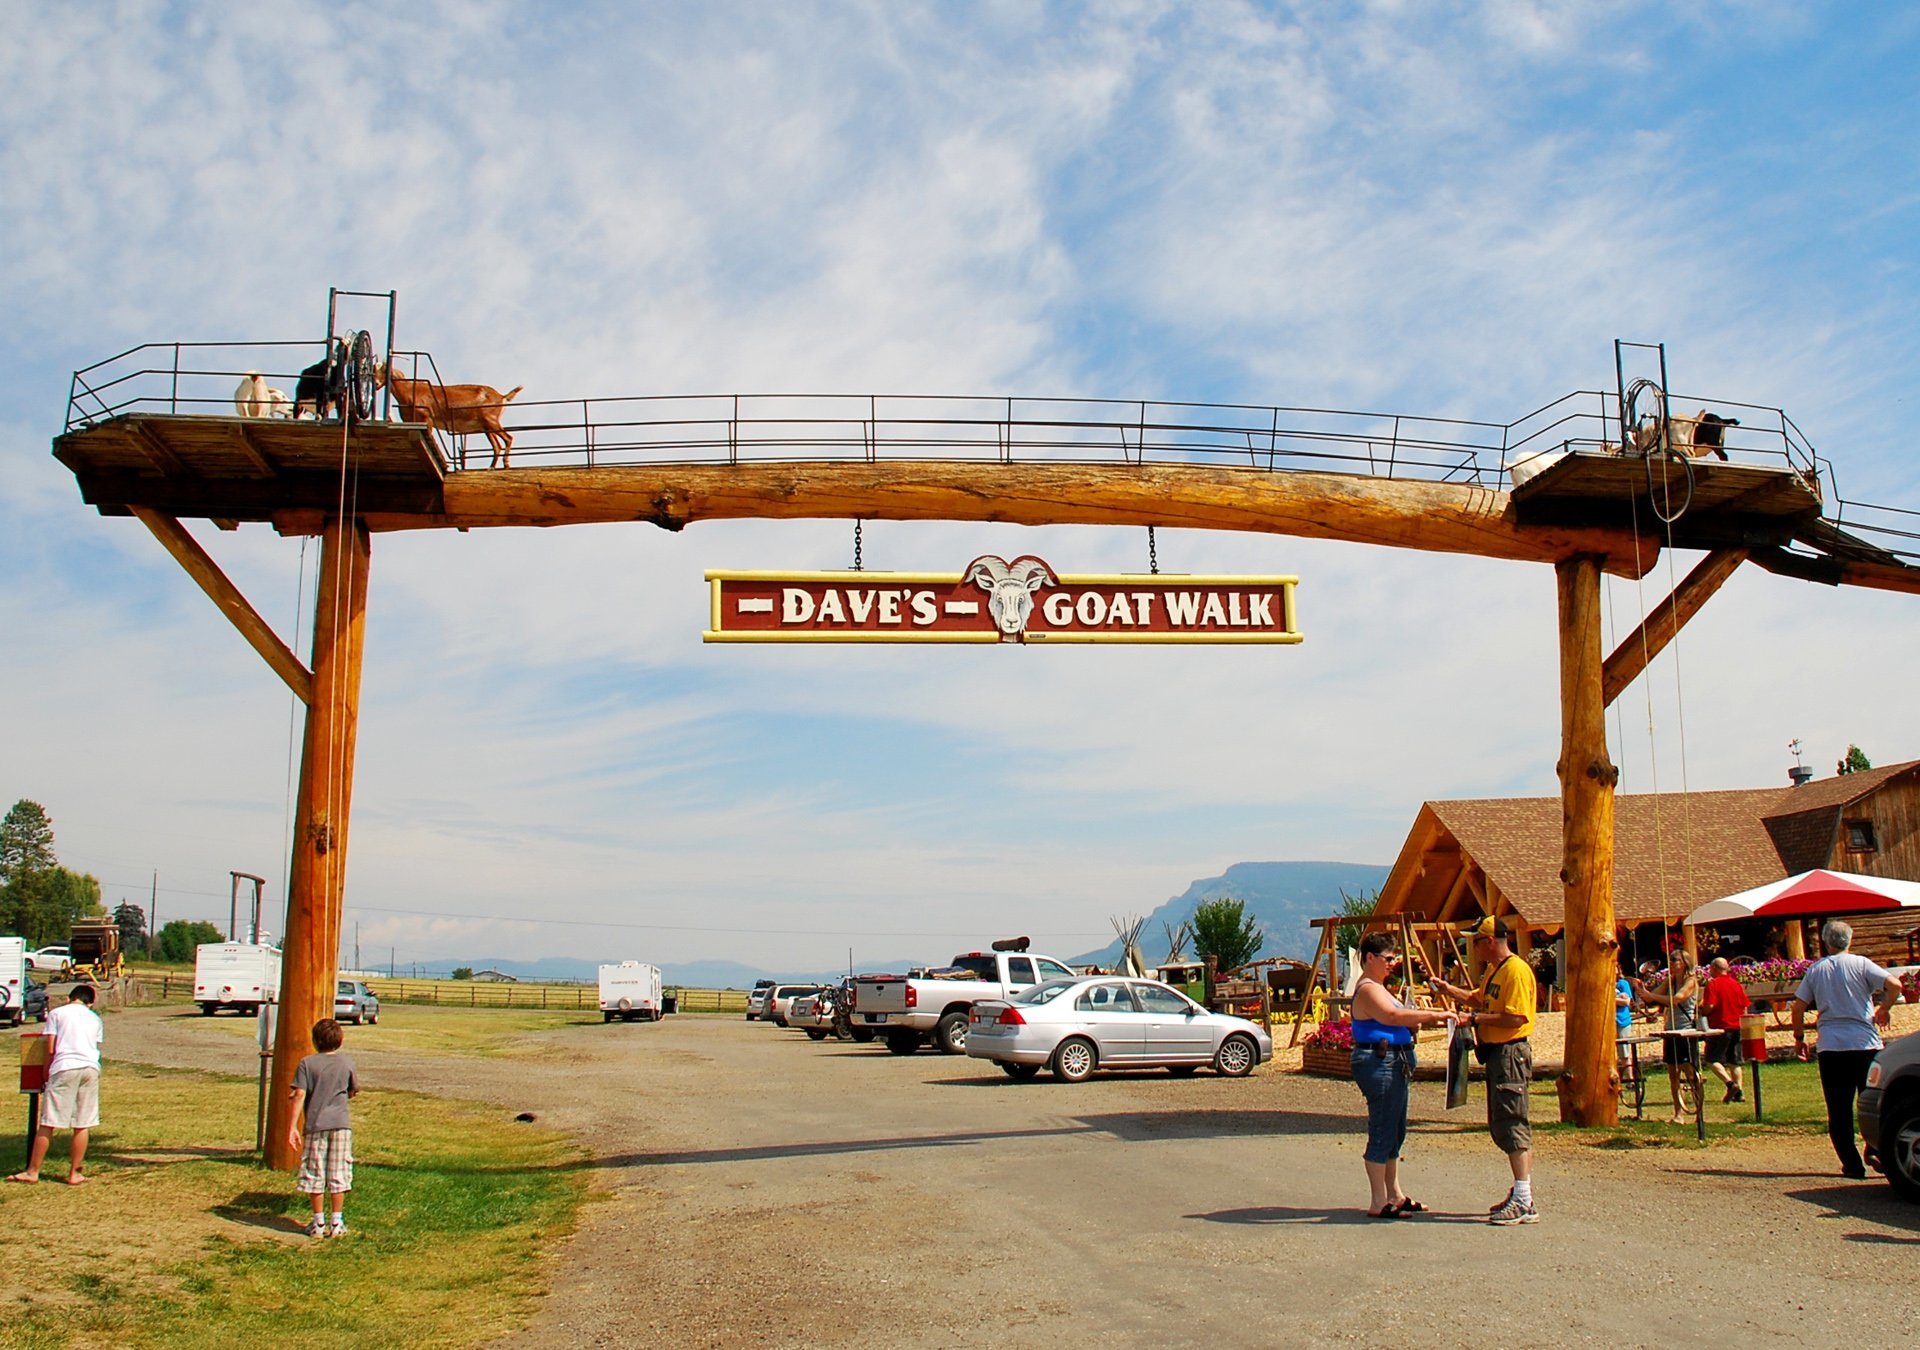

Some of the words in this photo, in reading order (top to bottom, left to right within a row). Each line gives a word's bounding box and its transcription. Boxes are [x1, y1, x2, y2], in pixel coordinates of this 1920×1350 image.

[782, 588, 937, 625] DAVE'S
[1042, 592, 1155, 626] GOAT
[1164, 592, 1275, 626] WALK
